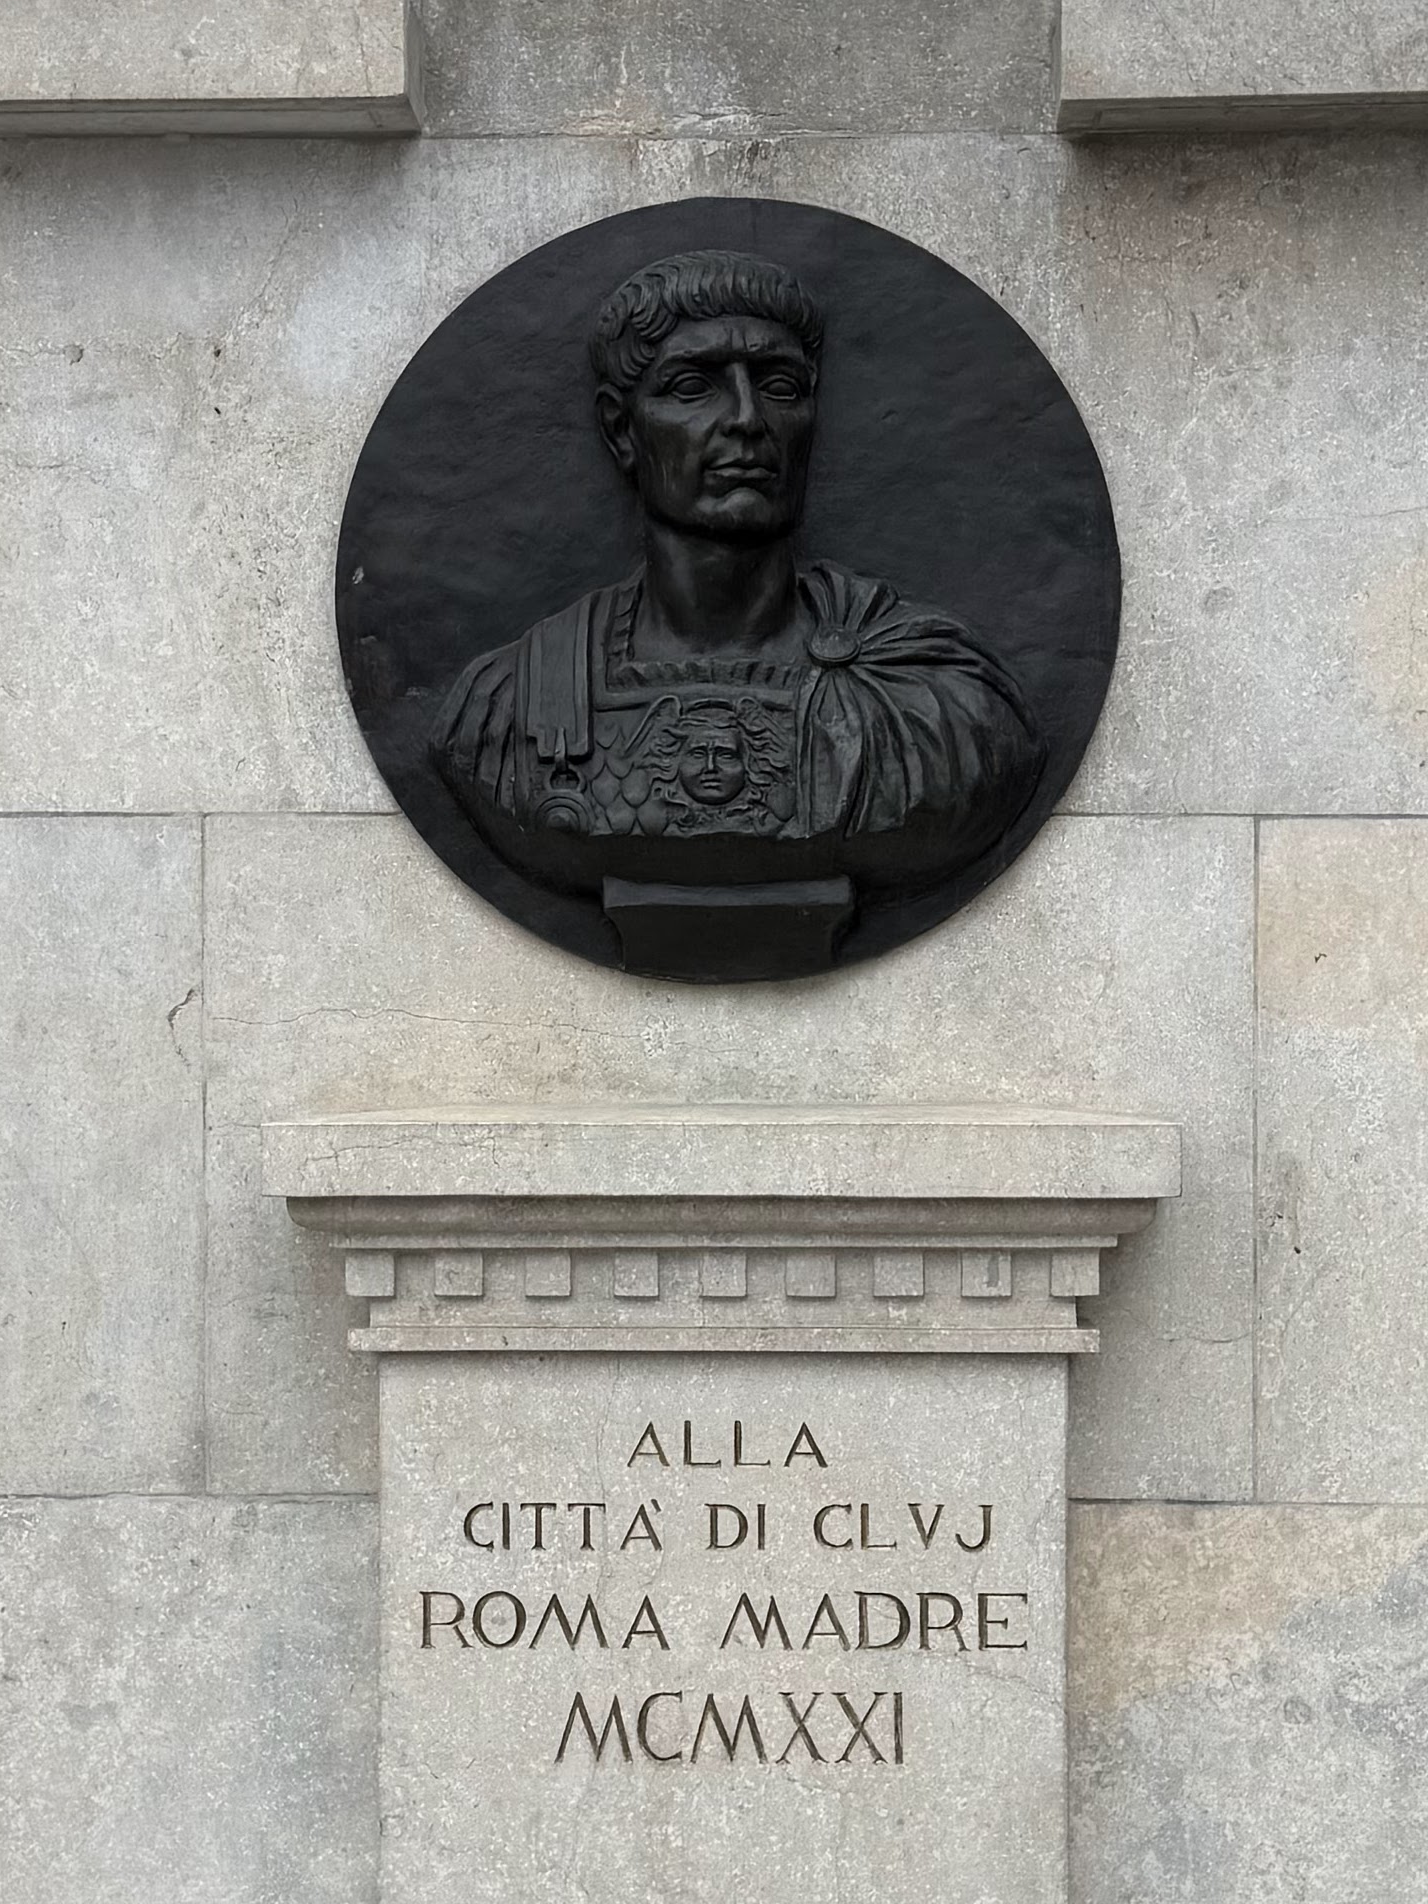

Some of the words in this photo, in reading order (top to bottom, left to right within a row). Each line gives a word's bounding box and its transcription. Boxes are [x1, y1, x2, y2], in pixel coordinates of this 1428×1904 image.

[627, 1419, 829, 1468] ALLA
[462, 1498, 664, 1552] CITTÀ
[707, 1502, 766, 1551] DI
[812, 1502, 994, 1553] CLVJ
[419, 1590, 671, 1650] ROMA
[720, 1590, 1029, 1652] MADRE
[554, 1691, 904, 1765] MCMXXI
